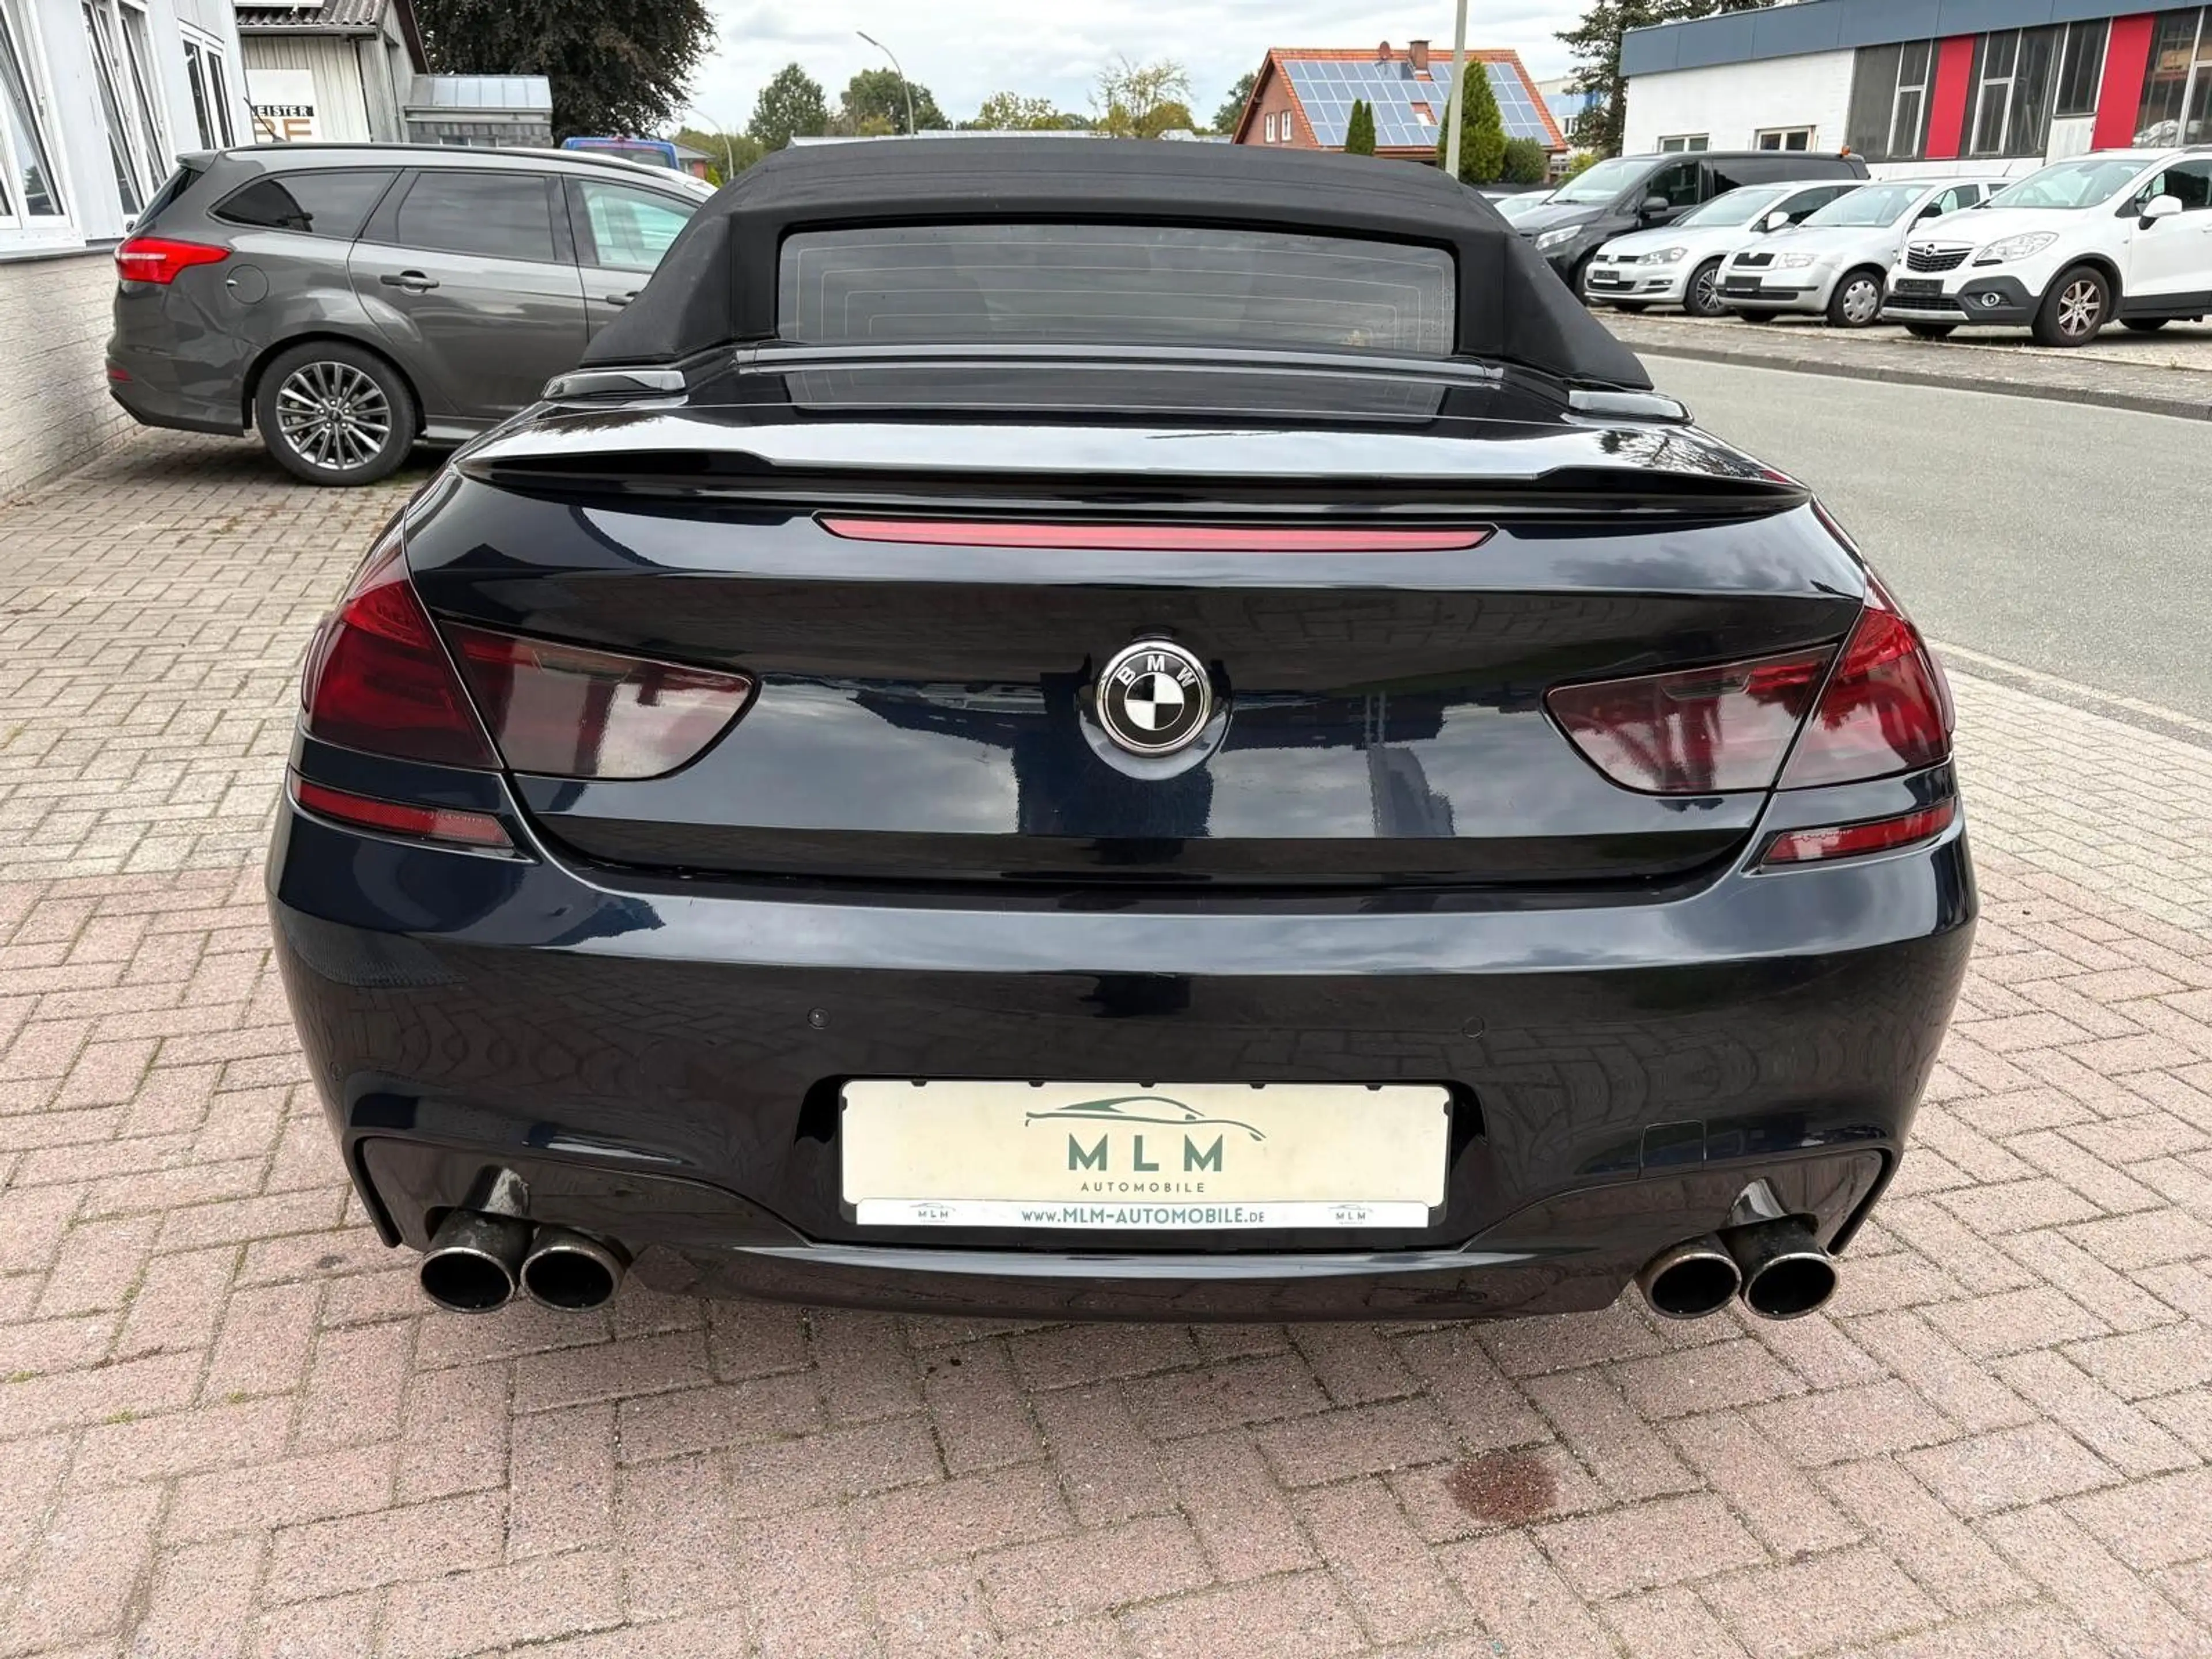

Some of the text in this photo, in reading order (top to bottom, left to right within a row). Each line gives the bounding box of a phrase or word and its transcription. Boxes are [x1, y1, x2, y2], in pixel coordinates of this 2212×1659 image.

[1115, 655, 1196, 687] BMW
[1069, 1133, 1223, 1172] MLM
[1081, 1181, 1205, 1193] AUTOMOBILE
[918, 1210, 948, 1218] MLM
